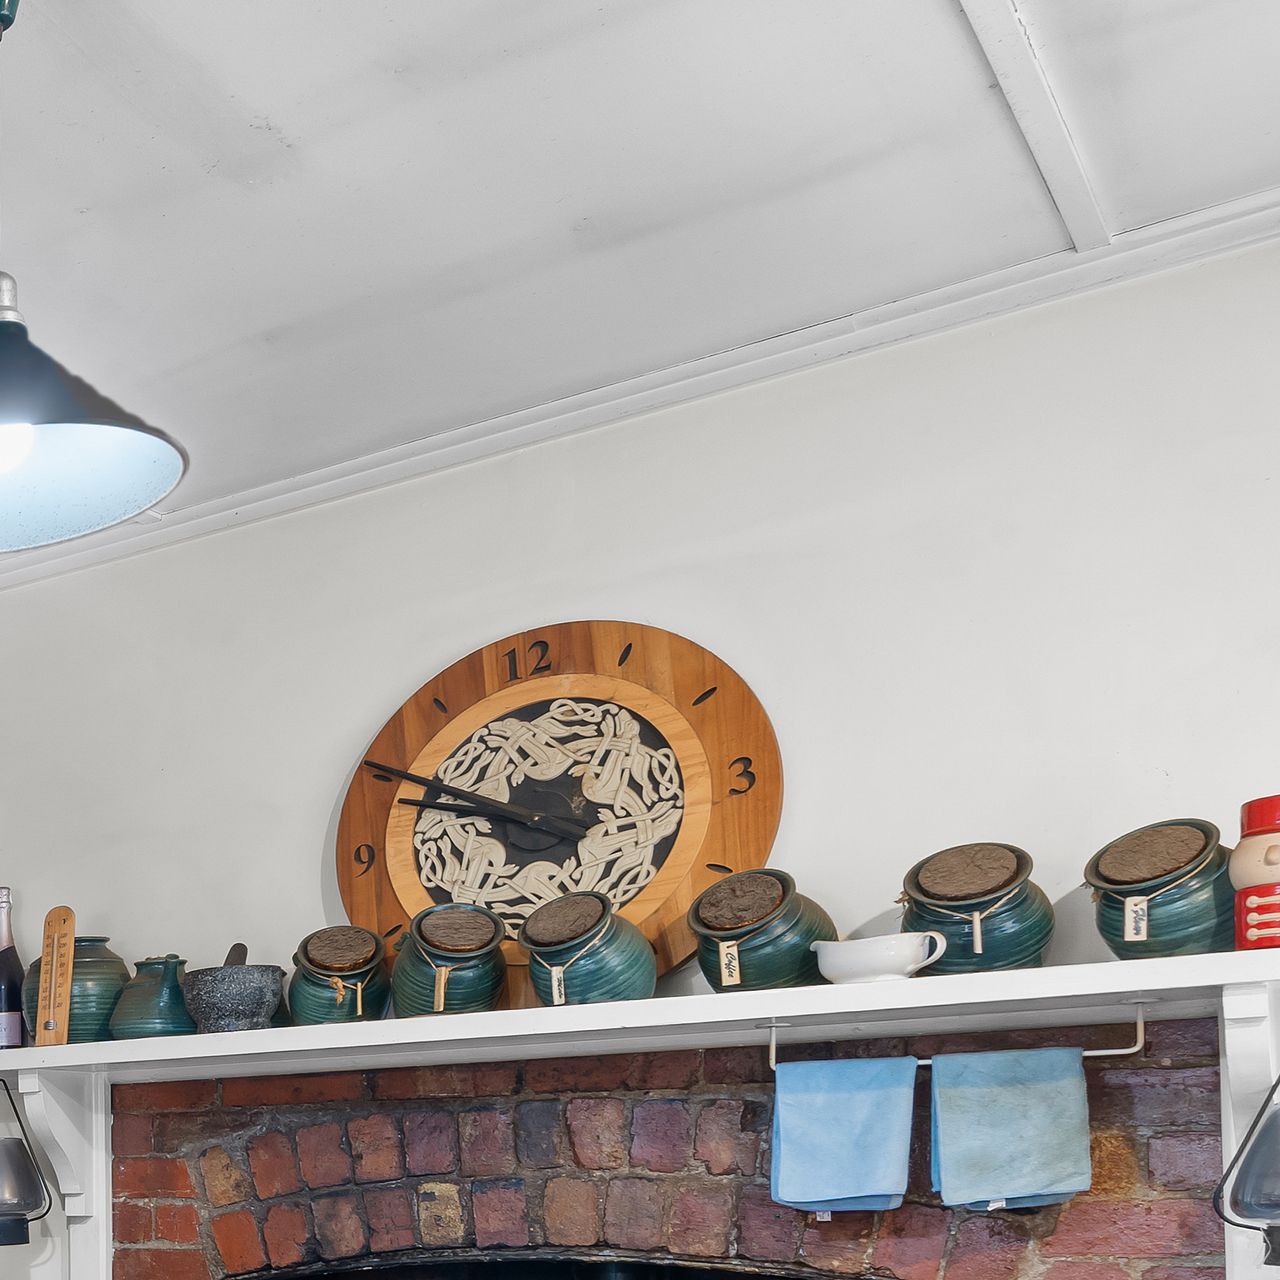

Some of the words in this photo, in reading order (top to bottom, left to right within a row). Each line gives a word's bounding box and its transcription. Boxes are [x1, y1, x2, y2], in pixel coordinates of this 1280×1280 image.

[502, 640, 552, 684] 12
[728, 756, 758, 797] 3
[353, 843, 377, 878] 9
[724, 952, 737, 978] Coffee
